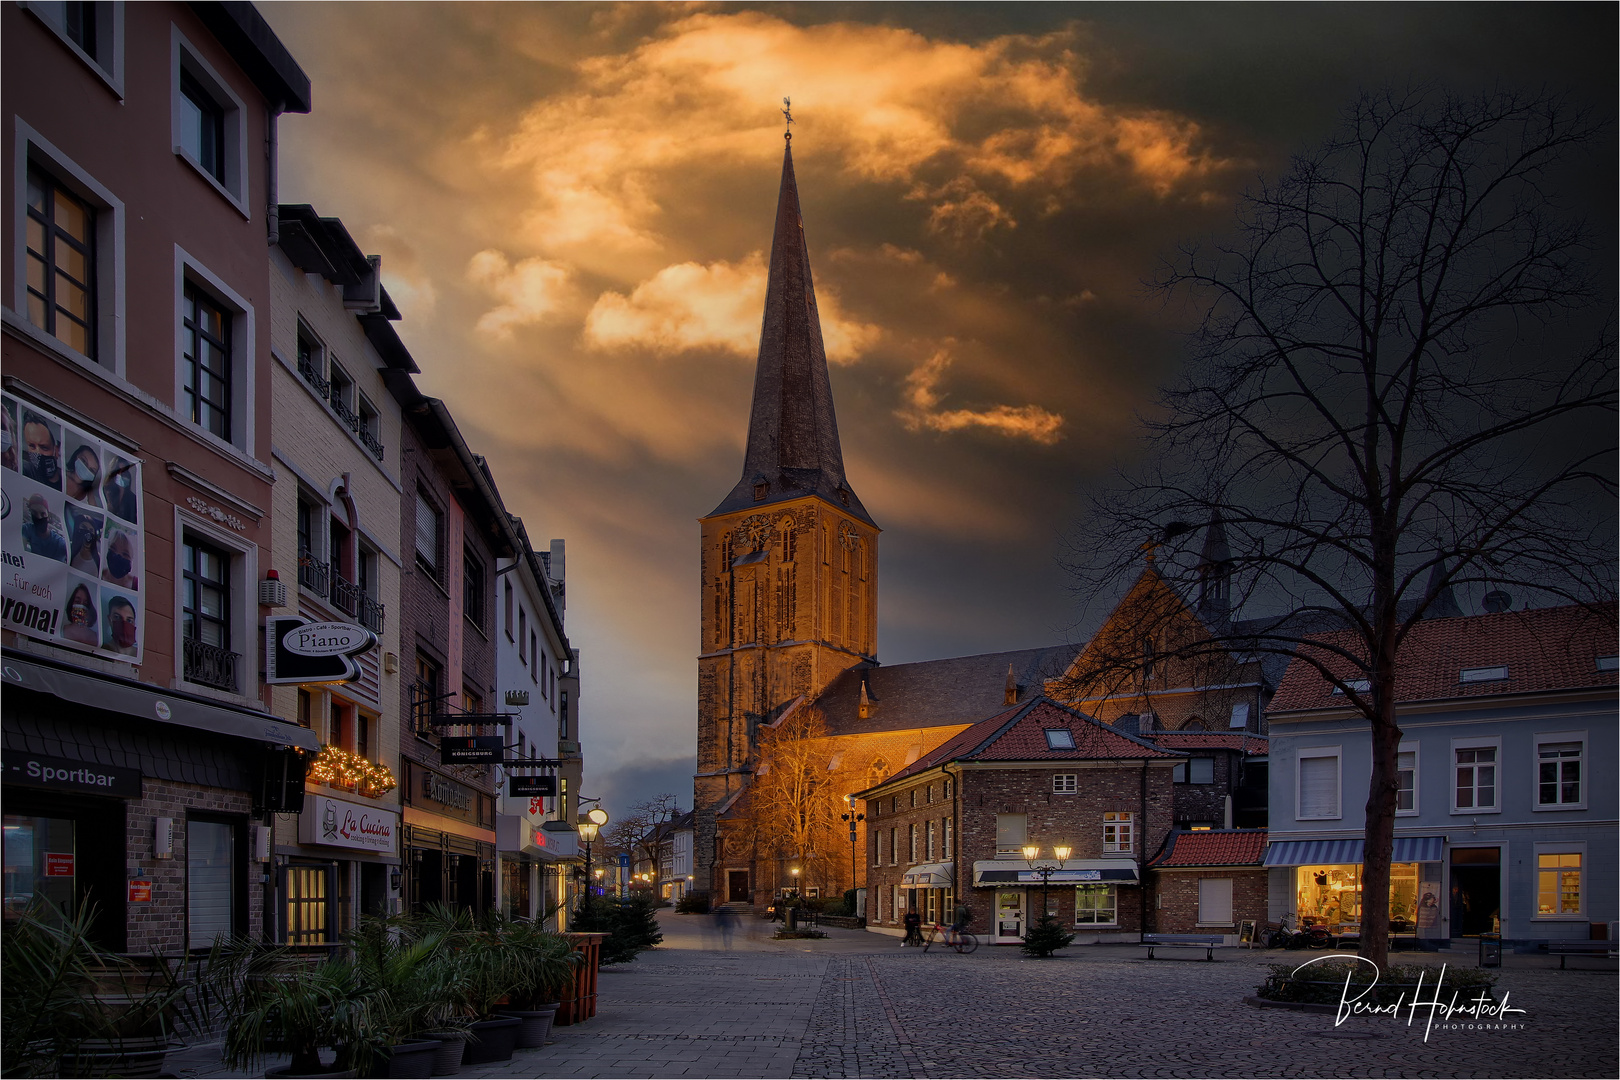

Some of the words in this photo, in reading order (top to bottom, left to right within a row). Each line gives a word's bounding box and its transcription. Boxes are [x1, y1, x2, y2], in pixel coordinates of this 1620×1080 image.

[1, 550, 25, 569] ite!
[31, 584, 52, 601] euch
[1, 595, 59, 635] rona!
[299, 634, 350, 648] Piano
[26, 760, 115, 787] Sportbar
[340, 809, 357, 839] La
[359, 813, 391, 837] Cucina
